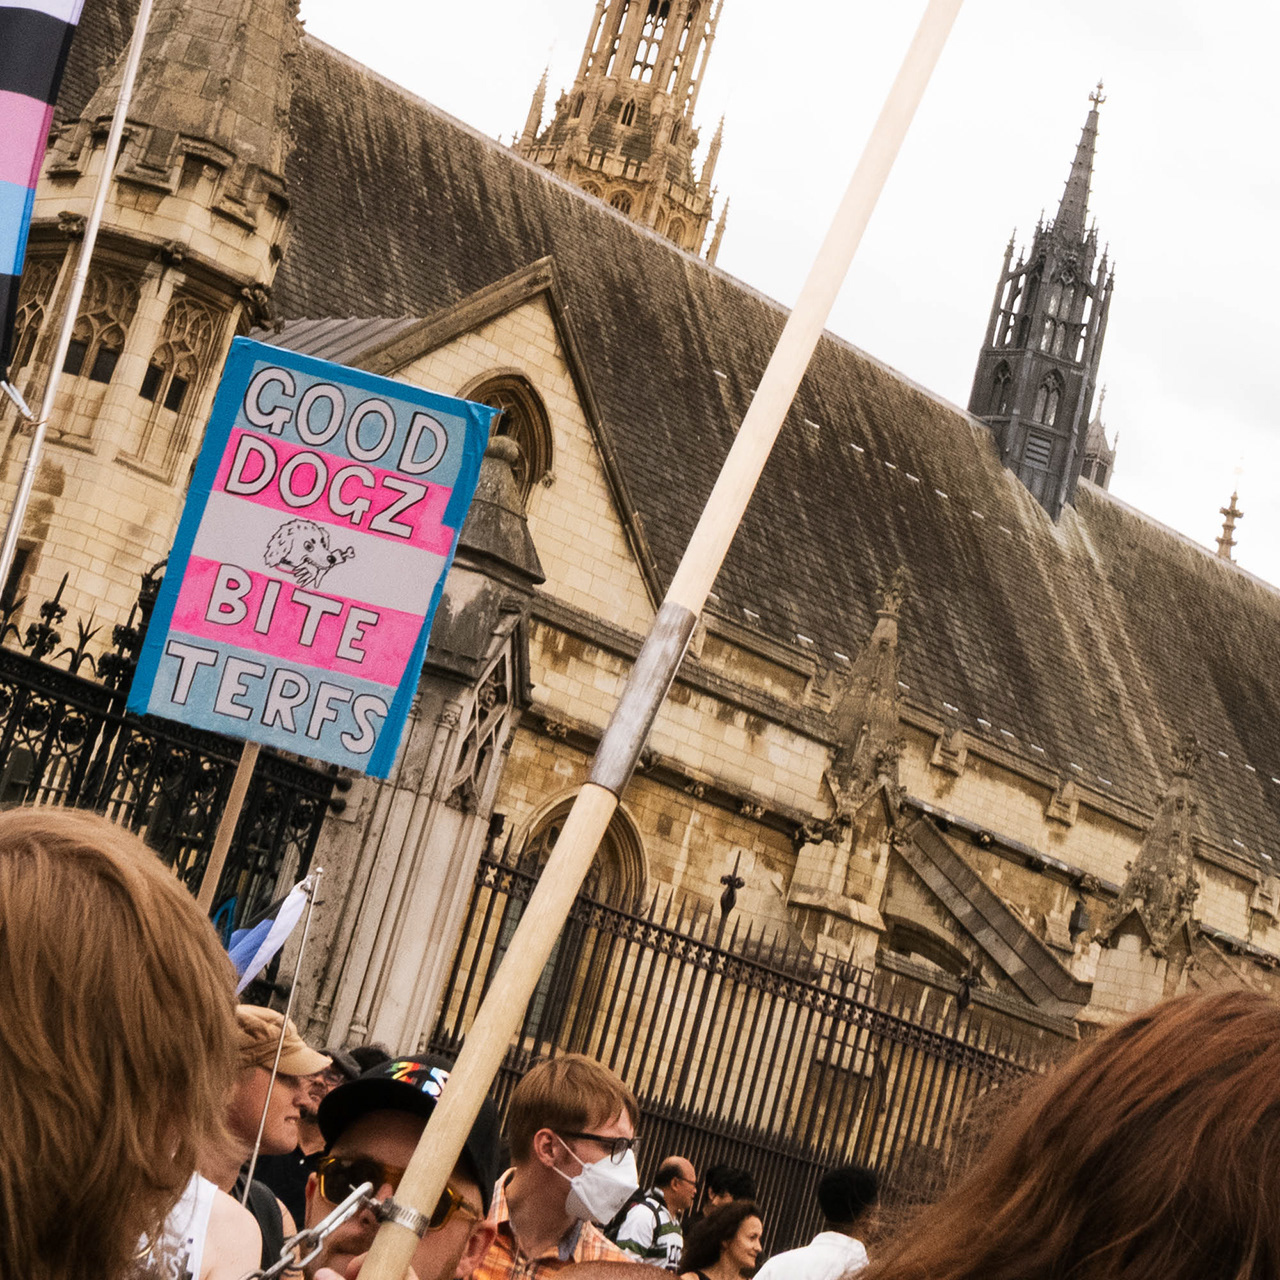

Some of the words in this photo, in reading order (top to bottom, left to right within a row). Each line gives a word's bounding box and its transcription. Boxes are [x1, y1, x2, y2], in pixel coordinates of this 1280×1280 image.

[243, 367, 448, 475] GOOD
[225, 434, 428, 538] DOGZ
[204, 563, 380, 663] BITE
[166, 640, 389, 754] TERFS
